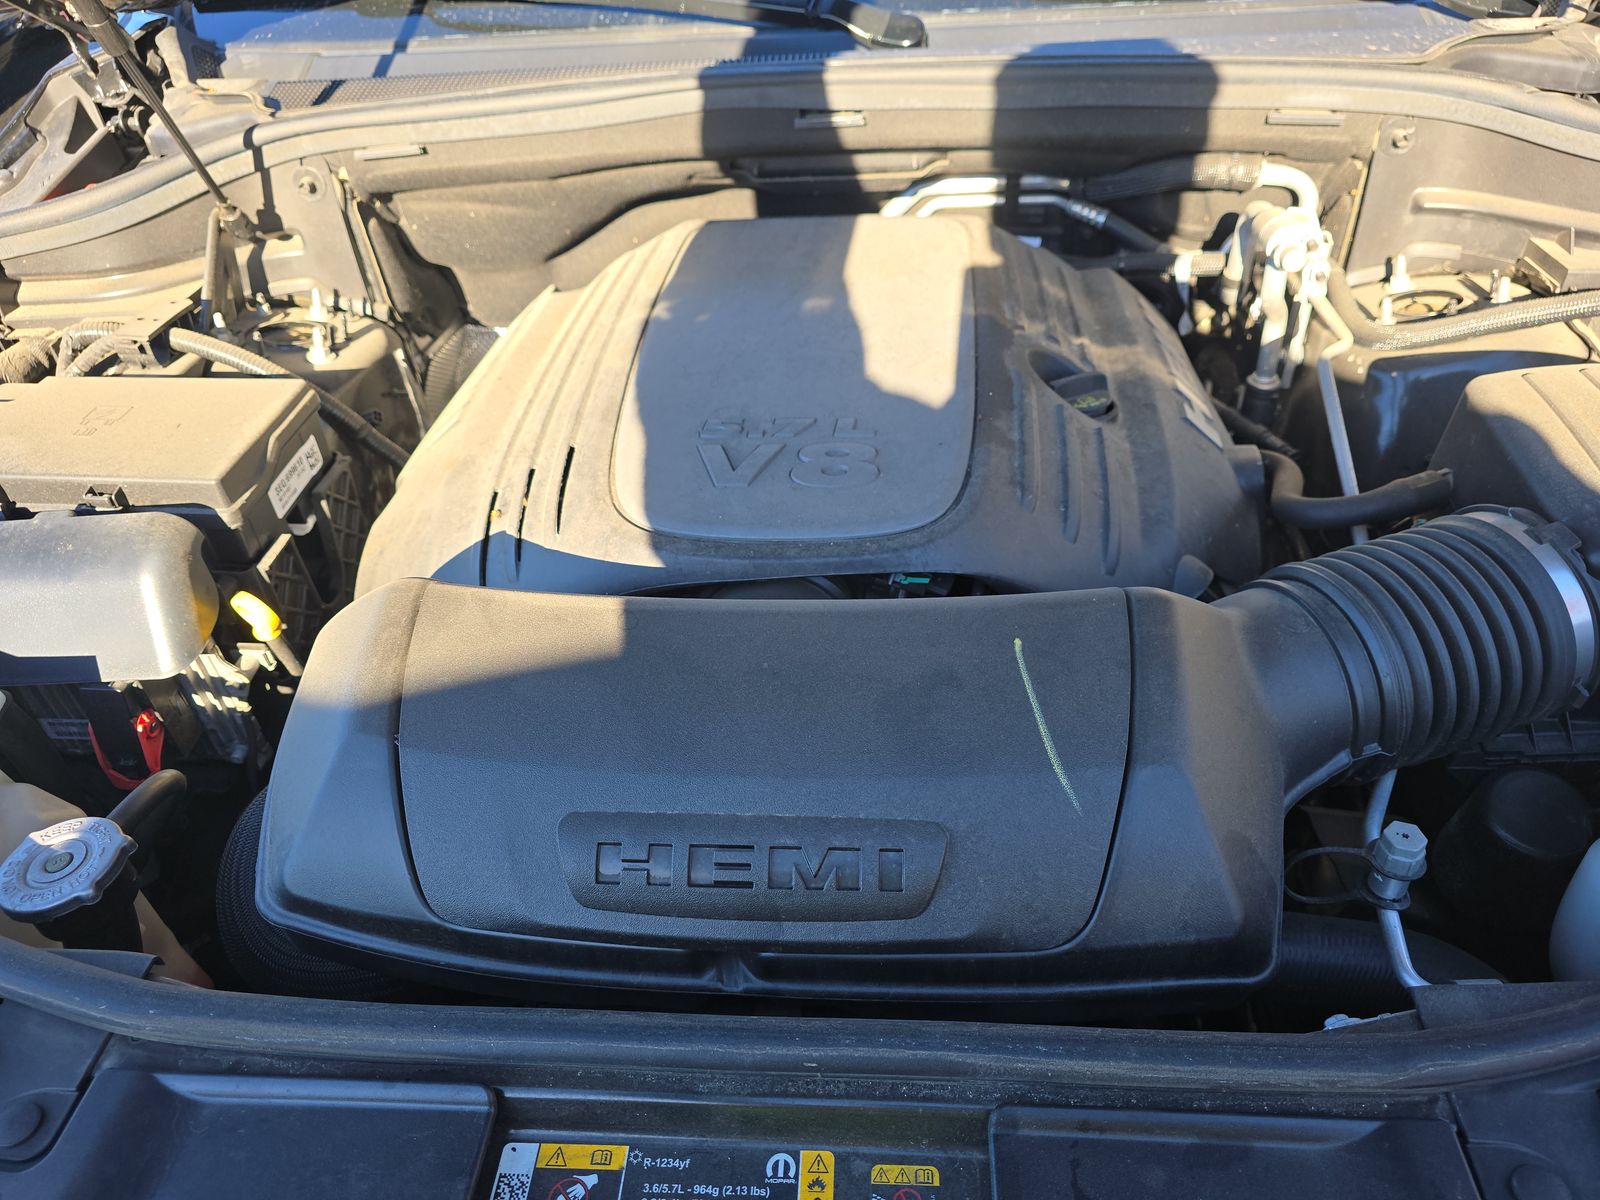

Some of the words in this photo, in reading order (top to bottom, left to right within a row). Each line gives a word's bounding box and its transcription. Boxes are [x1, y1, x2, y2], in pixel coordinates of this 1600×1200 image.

[698, 417, 878, 438] 5.7L
[696, 443, 881, 488] V8
[40, 820, 83, 842] KEEP
[595, 841, 904, 892] HEMI
[643, 1158, 691, 1171] R-1234yf
[643, 1183, 685, 1194] 3.6/5.7L
[693, 1184, 720, 1197] 964g
[722, 1185, 748, 1197] (2.13
[750, 1186, 770, 1198] lbs)
